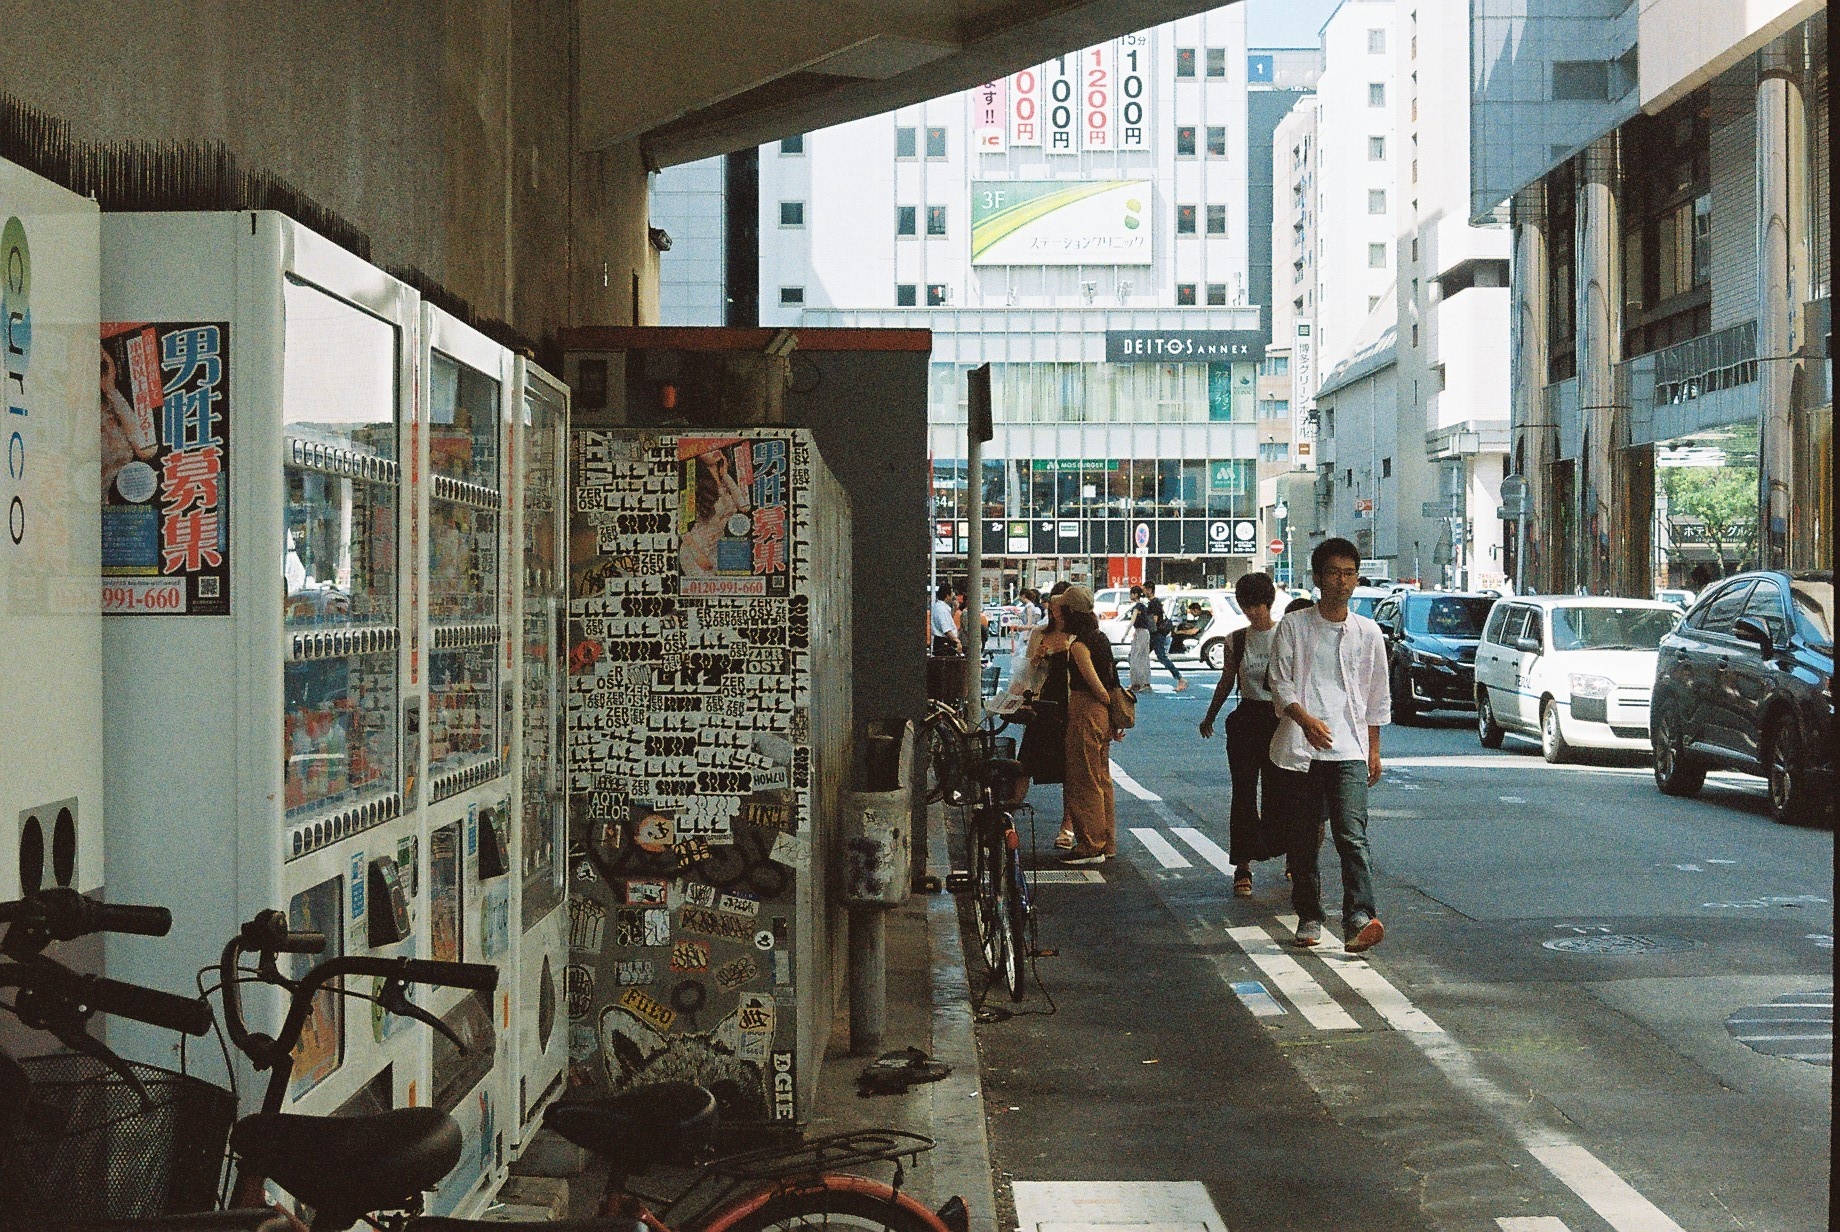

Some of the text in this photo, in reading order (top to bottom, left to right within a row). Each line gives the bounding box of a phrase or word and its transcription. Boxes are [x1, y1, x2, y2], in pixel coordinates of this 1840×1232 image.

[1256, 63, 1263, 74] 1
[1087, 49, 1107, 145] 1200円
[1123, 50, 1143, 145] 100円
[981, 190, 1006, 209] 3F
[1030, 236, 1144, 249] ステーションクリニック
[1124, 338, 1249, 355] DEITOS ANNEX
[161, 325, 224, 575] 男性募集
[579, 488, 602, 499] ZER
[752, 439, 787, 576] 男性募集
[600, 525, 618, 535] ZER
[1216, 525, 1225, 537] P
[642, 554, 664, 565] ZER
[690, 581, 763, 595] 0120-991-660
[586, 619, 603, 627] ZER
[730, 641, 747, 650] ZER
[748, 660, 785, 674] OSY
[722, 676, 745, 687] ZER
[706, 696, 724, 705] ZER
[606, 707, 629, 718] ZER
[632, 779, 649, 788] ZER
[591, 792, 626, 806] AQTY
[587, 805, 630, 821] XELOR
